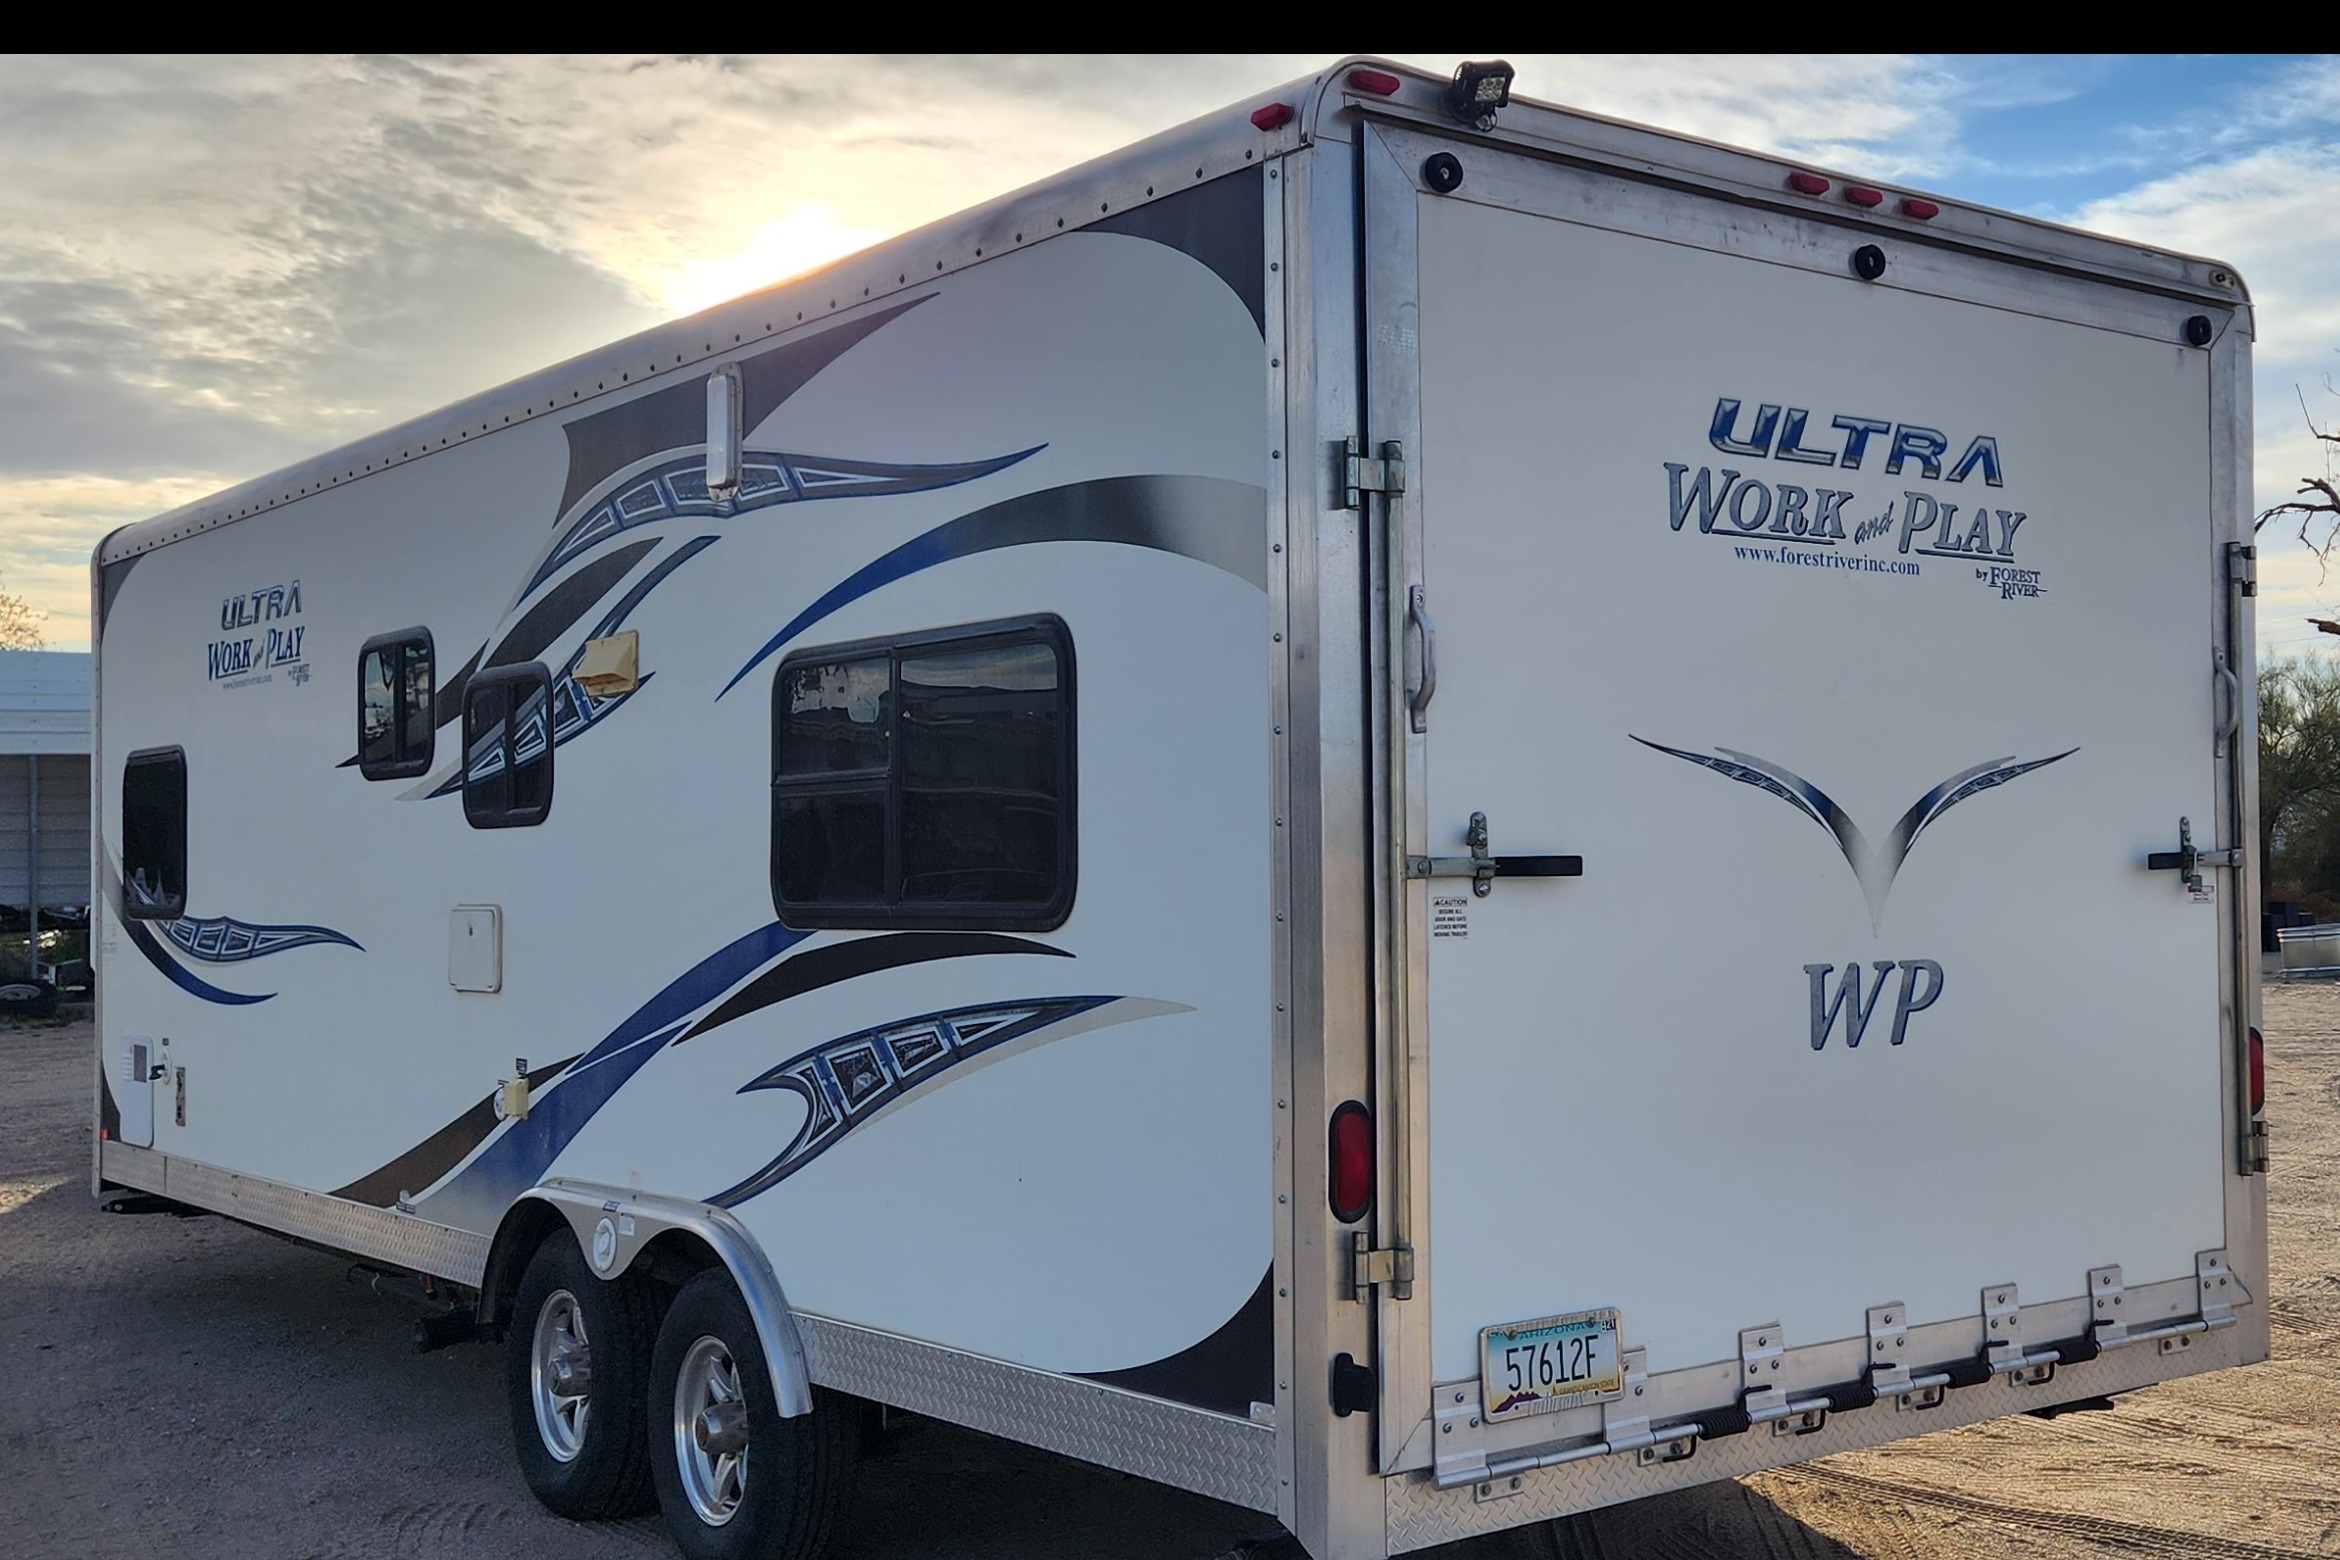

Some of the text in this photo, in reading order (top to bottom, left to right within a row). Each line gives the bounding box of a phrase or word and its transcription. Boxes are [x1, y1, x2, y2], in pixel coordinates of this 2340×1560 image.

[1709, 397, 2003, 488] ULTRA
[1663, 461, 2027, 557] WORK and PLAY
[1734, 545, 1921, 576] www.forestriverinc.com
[1976, 566, 2041, 585] by FOREST
[221, 579, 302, 631] ULTRA
[2001, 581, 2040, 600] RIVER
[208, 638, 253, 681] WORK
[265, 625, 305, 670] PLAY
[1803, 959, 1944, 1051] WP
[1519, 1325, 1586, 1340] ARIZONA
[1506, 1334, 1599, 1391] 57612F
